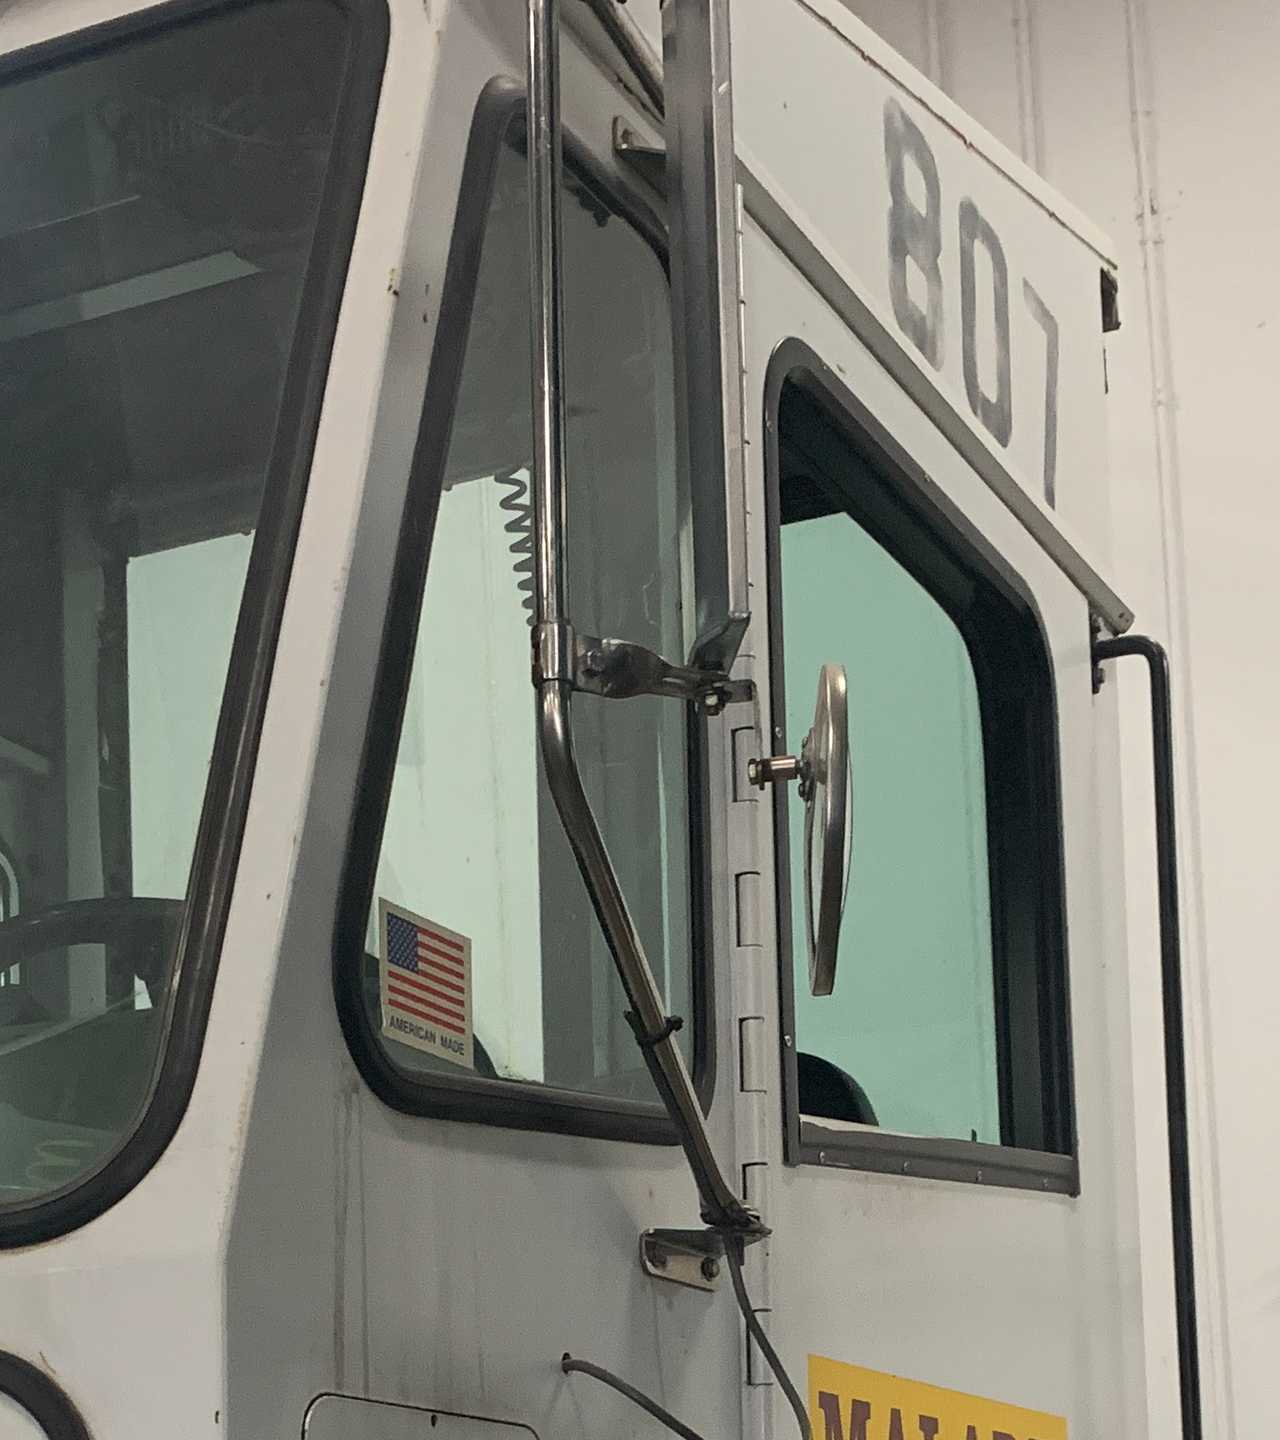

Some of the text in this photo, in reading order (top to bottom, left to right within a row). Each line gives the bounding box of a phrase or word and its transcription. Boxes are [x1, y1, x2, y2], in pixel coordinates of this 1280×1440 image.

[883, 97, 1059, 511] 807
[389, 1015, 465, 1056] AMERICAN MADE
